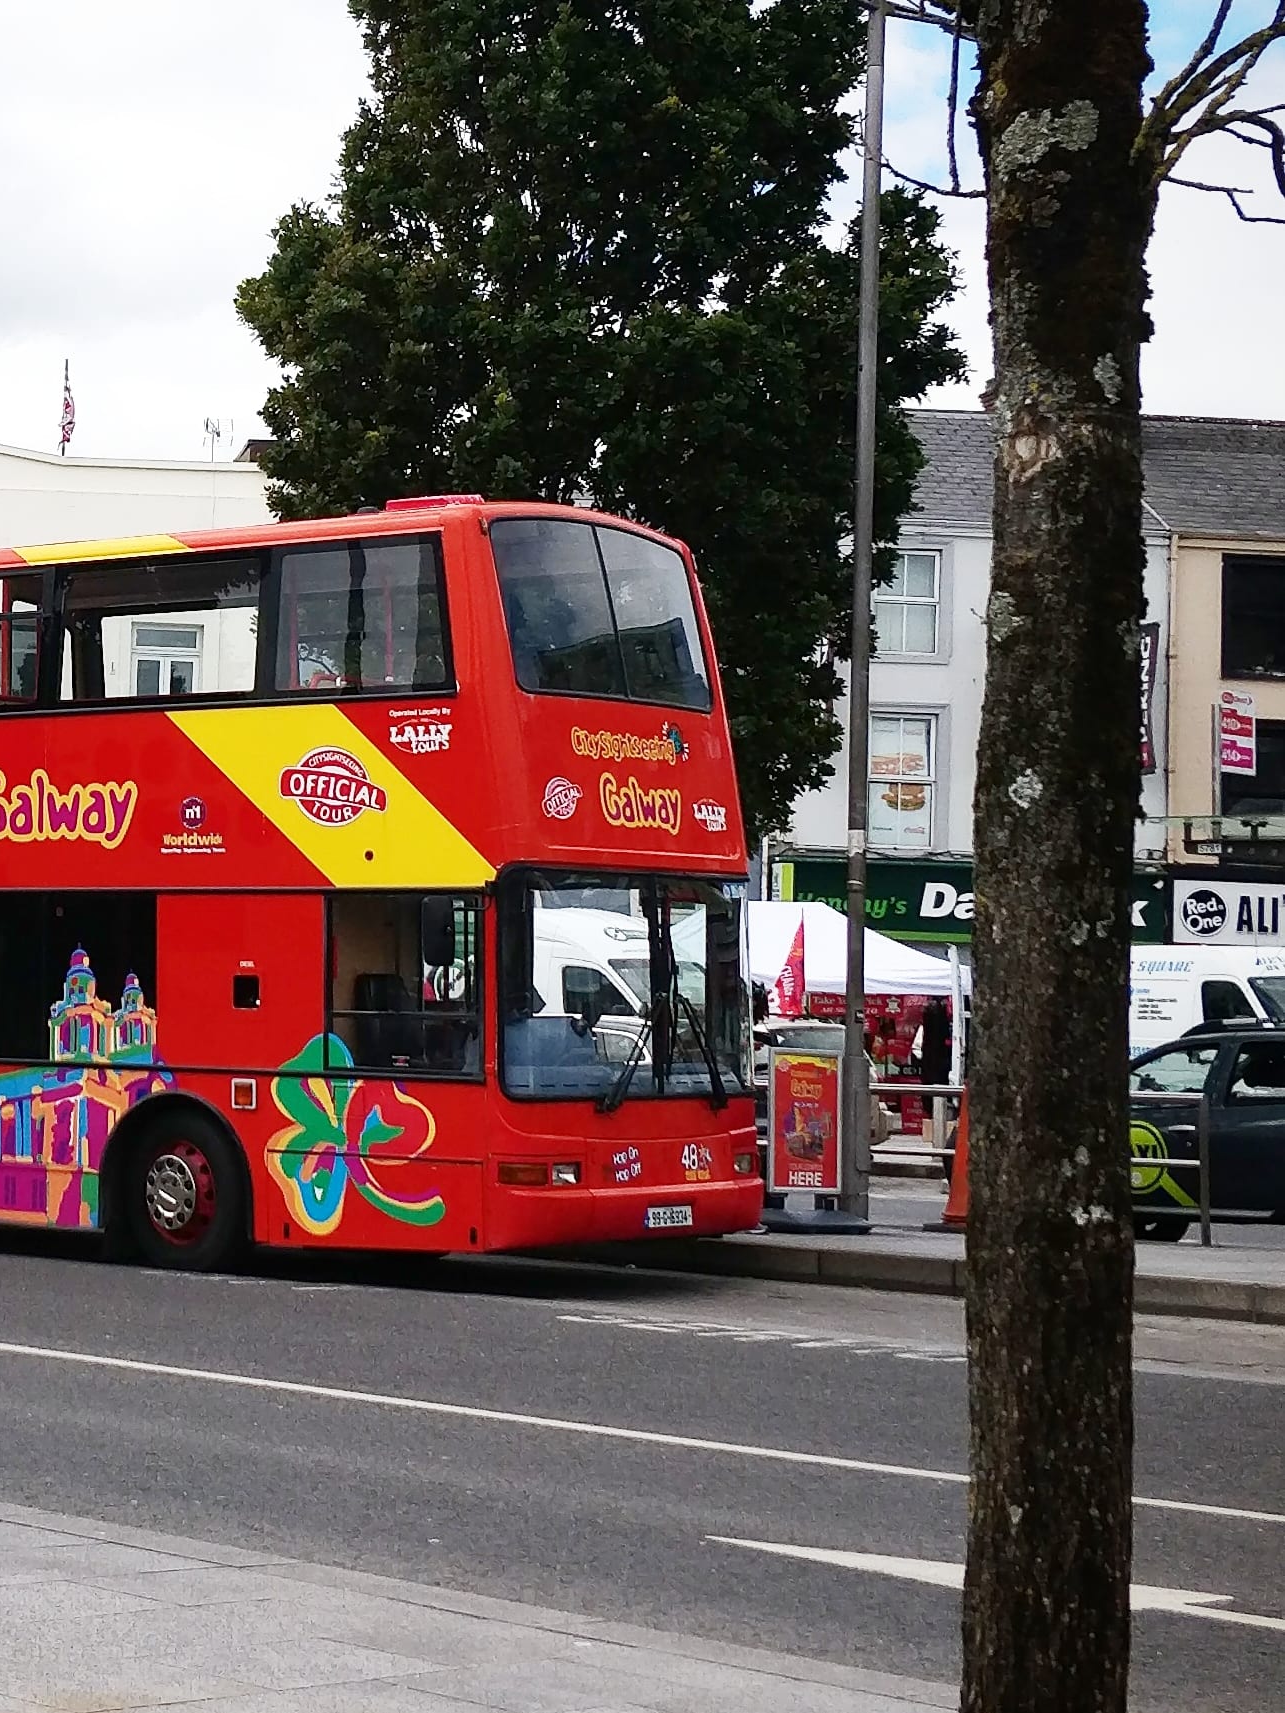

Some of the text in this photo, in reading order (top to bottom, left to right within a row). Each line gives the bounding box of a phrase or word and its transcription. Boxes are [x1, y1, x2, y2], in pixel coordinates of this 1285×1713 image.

[389, 707, 452, 718] Operated Locally By
[389, 724, 453, 743] LALLY
[571, 726, 677, 766] CitySightseeing
[308, 752, 365, 777] CITYSIGHTSEEING
[289, 773, 381, 809] OFFICIAL
[546, 787, 580, 812] OFFICIAL
[312, 801, 354, 822] TOUR
[599, 772, 682, 836] Galway
[692, 803, 727, 821] LALLY
[1186, 914, 1223, 932] One
[613, 1146, 639, 1165] Hop On
[681, 1143, 698, 1170] 48
[615, 1162, 641, 1182] Hop Off
[788, 1171, 824, 1186] HERE
